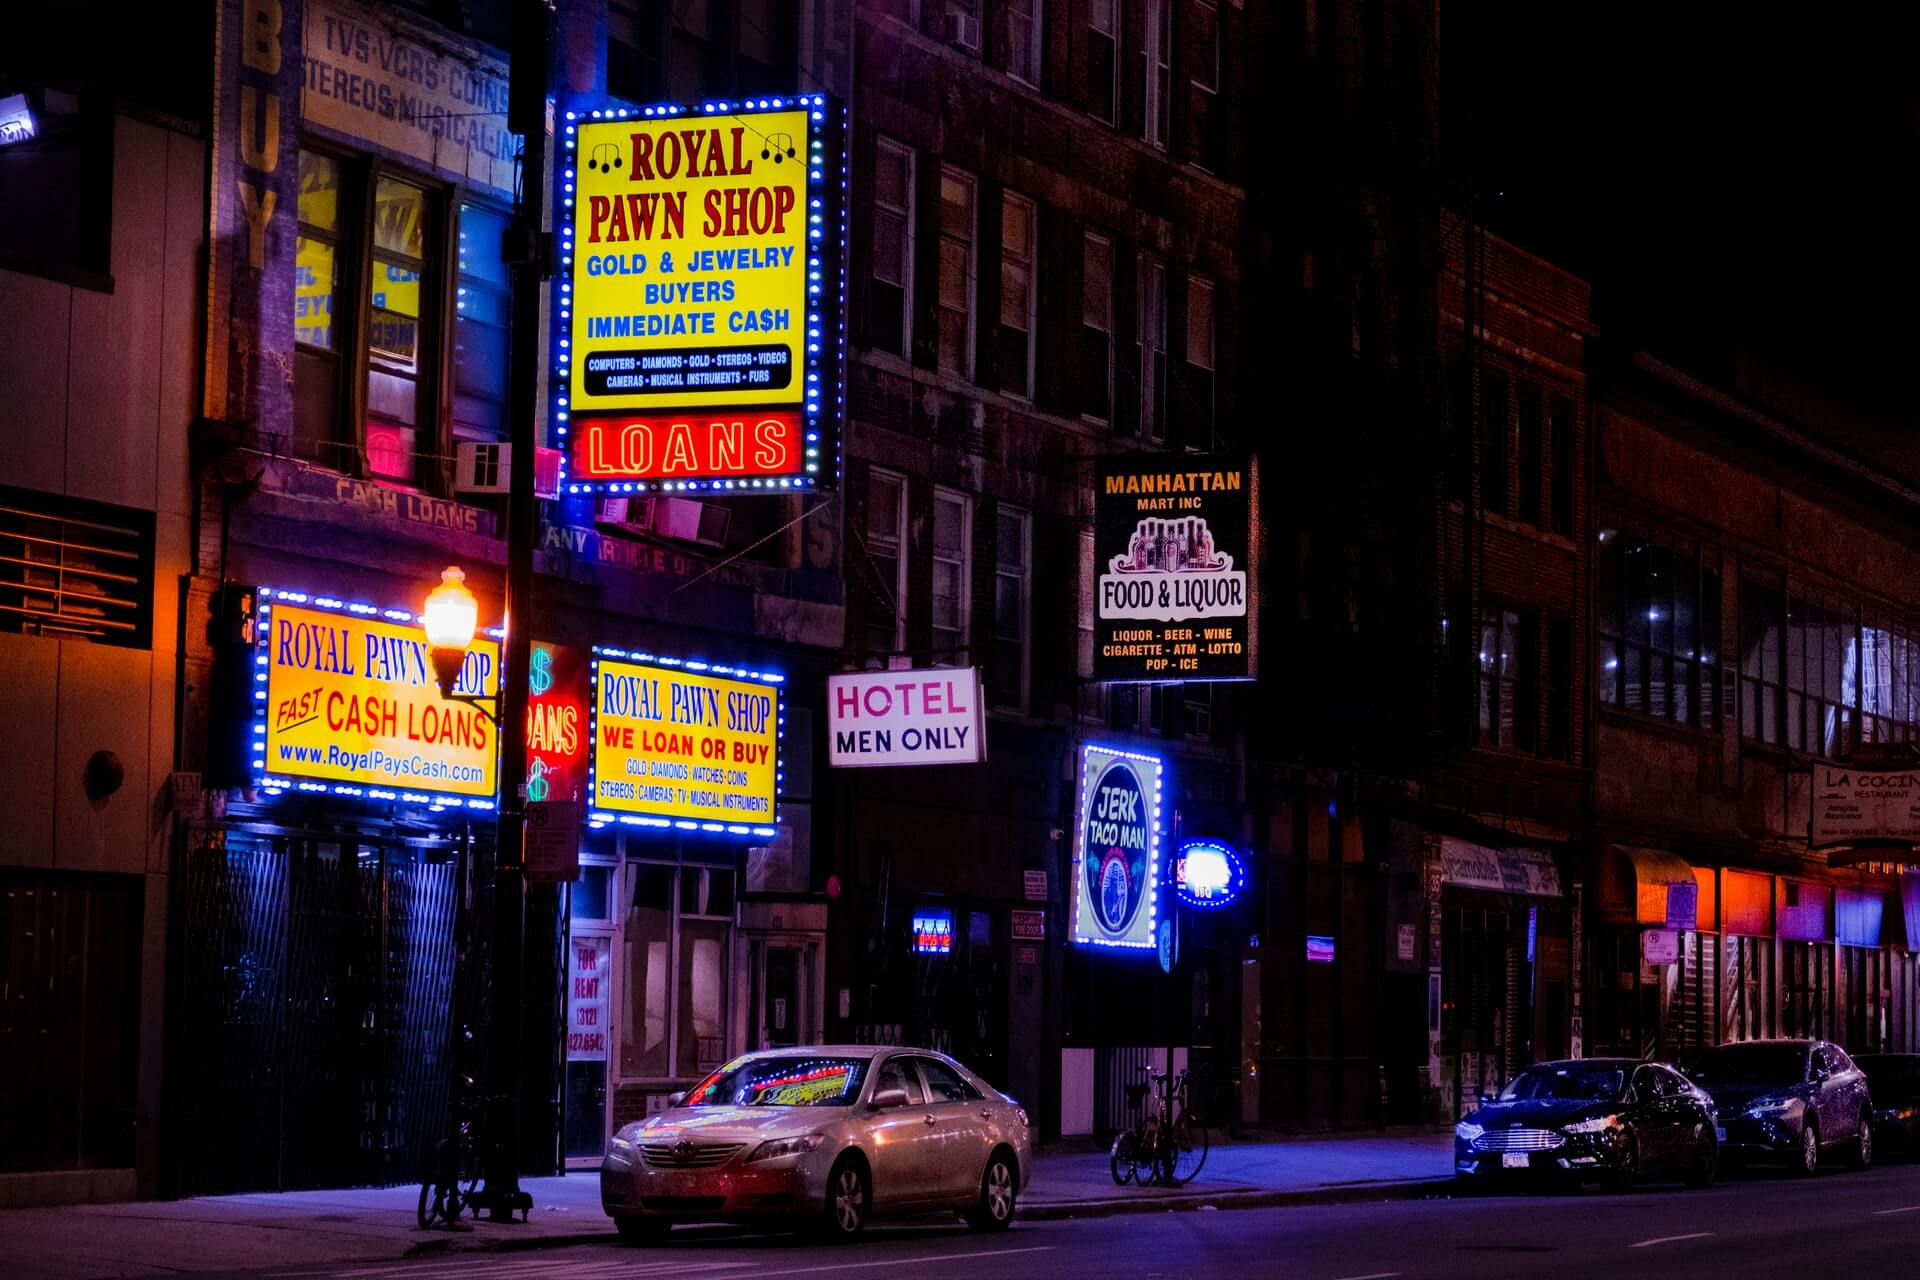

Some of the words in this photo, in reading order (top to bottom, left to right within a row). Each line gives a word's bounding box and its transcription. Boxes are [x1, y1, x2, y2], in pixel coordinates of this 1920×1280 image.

[324, 15, 369, 63] TVS
[239, 0, 282, 269] BUY
[629, 127, 753, 181] ROYAL
[588, 191, 687, 243] PAWN
[702, 185, 795, 237] SHOP
[587, 254, 647, 276] GOLD
[659, 251, 674, 273] &
[687, 246, 794, 272] JEWELRY
[645, 280, 735, 304] BUYERS
[587, 312, 715, 338] IMMEDIATE
[728, 308, 790, 334] CA$H
[588, 357, 635, 371] COMPUTERS
[642, 355, 682, 369] DIAMONDS
[689, 354, 710, 367] GOLD
[717, 353, 752, 366] STEREOS
[758, 351, 787, 364] VIDEOS
[606, 374, 644, 388] CAMERAS
[650, 373, 684, 387] MUSICAL
[687, 370, 741, 385] INSTRUMENTS
[748, 370, 770, 383] FURS
[589, 419, 786, 474] LOANS
[1104, 471, 1242, 495] MANHATTAN
[407, 495, 478, 533] LOANS
[1136, 497, 1175, 511] MART
[1178, 496, 1202, 510] INC
[1103, 580, 1153, 609] FOOD
[1158, 580, 1170, 608] &
[1174, 578, 1242, 612] LIQUOR
[1103, 643, 1163, 657] CIGARETTE
[1173, 643, 1197, 655] ATM
[1208, 642, 1242, 655] LOTTO
[1112, 630, 1152, 642] LIQUOR
[1164, 628, 1192, 641] BEER
[1203, 627, 1232, 640] WINE
[278, 619, 354, 676] ROYAL
[365, 633, 427, 686] PAWN
[438, 650, 491, 698] OP
[1146, 659, 1168, 671] POP
[1179, 658, 1198, 670] ICE
[603, 673, 663, 721] ROYAL
[670, 683, 720, 727] PAWN
[727, 691, 770, 734] SHOP
[837, 681, 967, 719] HOTEL
[277, 687, 323, 728] FAST
[327, 691, 397, 737] CASH
[408, 703, 486, 750] LOANS
[527, 702, 579, 756] ANS
[603, 725, 634, 749] WE
[643, 730, 693, 756] LOAN
[701, 737, 726, 760] OR
[733, 742, 769, 765] BUY
[837, 729, 892, 753] MEN
[902, 726, 969, 750] ONLY
[280, 743, 484, 784] www.RoyalPaysCash.com
[626, 759, 646, 776] GOLD
[651, 761, 688, 780] DIAMONDS
[692, 766, 724, 784] WATCHES
[727, 770, 747, 787] COINS
[1826, 769, 1850, 787] LA
[600, 781, 634, 799] STEREOS
[638, 785, 673, 803] CAMERAS
[677, 788, 687, 803] TV
[690, 791, 720, 808] MUSICAL
[722, 794, 769, 812] INSTRUMENTS
[1097, 786, 1139, 822] JERK
[1090, 820, 1118, 847] TACO
[578, 948, 597, 970] FOR
[575, 978, 599, 999] RENT
